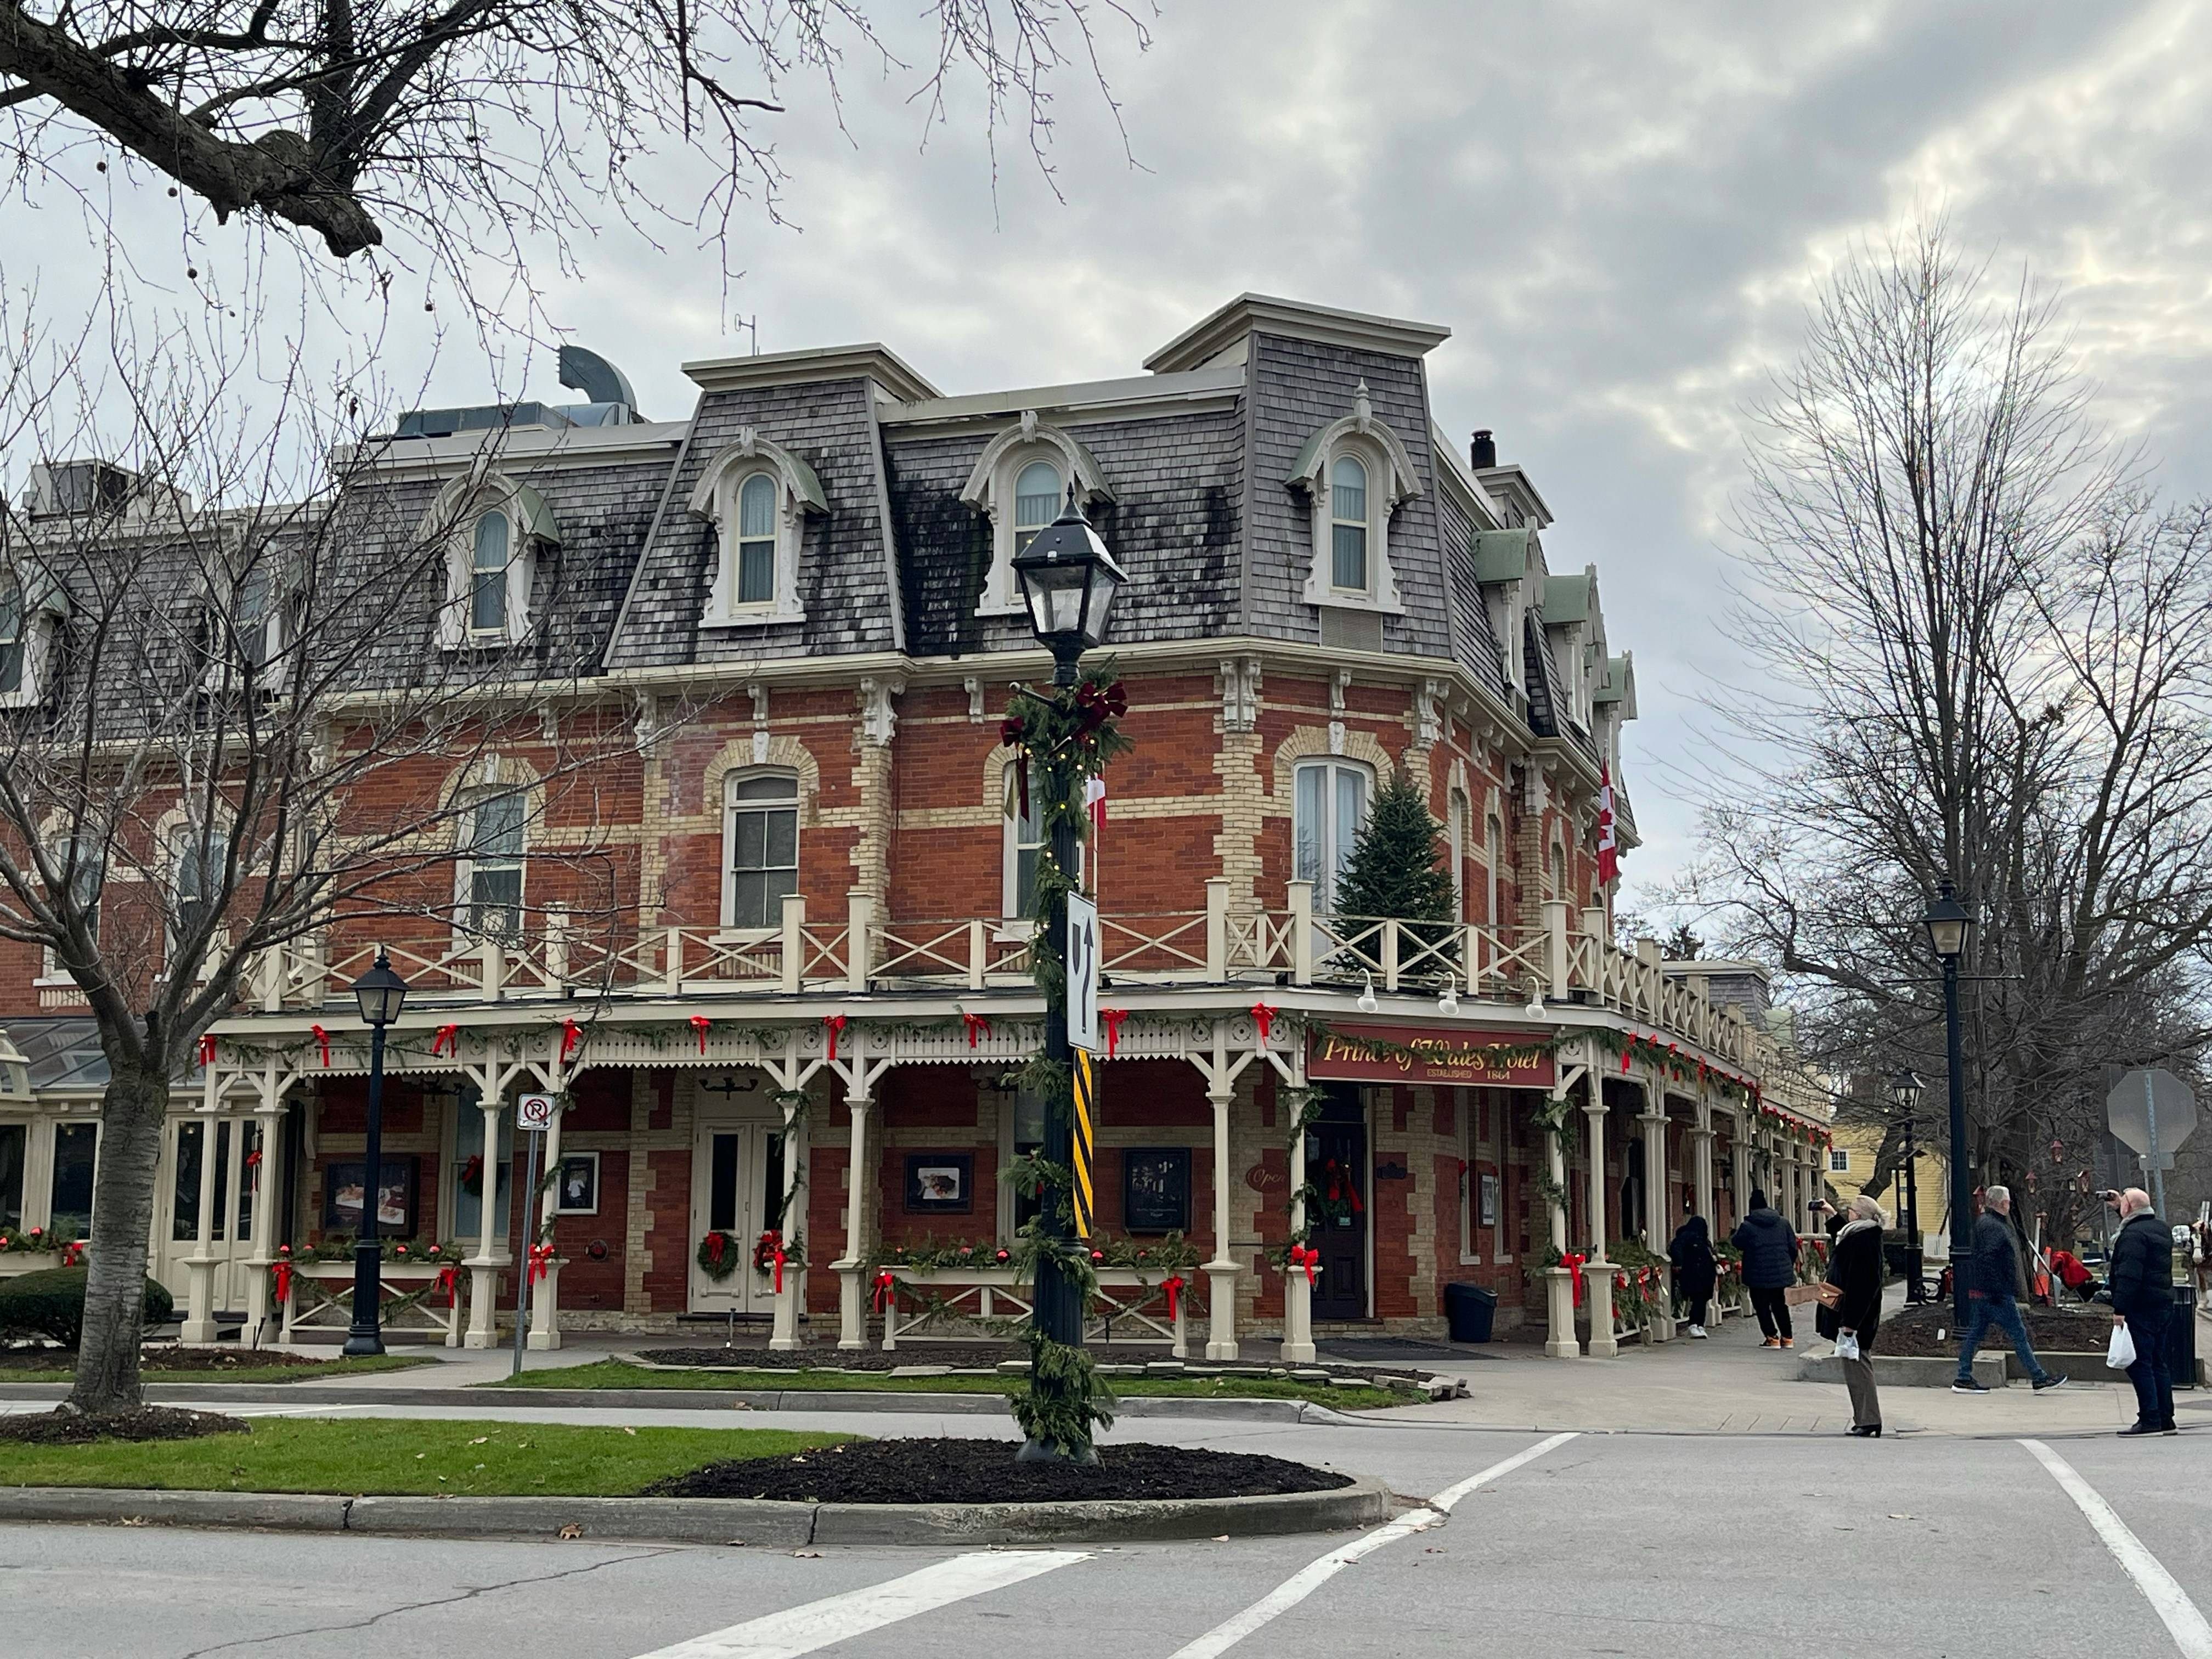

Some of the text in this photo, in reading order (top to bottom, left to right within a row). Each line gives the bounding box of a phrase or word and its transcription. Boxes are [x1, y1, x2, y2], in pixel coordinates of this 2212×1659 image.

[1395, 1038, 1421, 1071] of
[1427, 1069, 1510, 1080] ESTABLISHED 1864
[1254, 1169, 1285, 1187] Open
